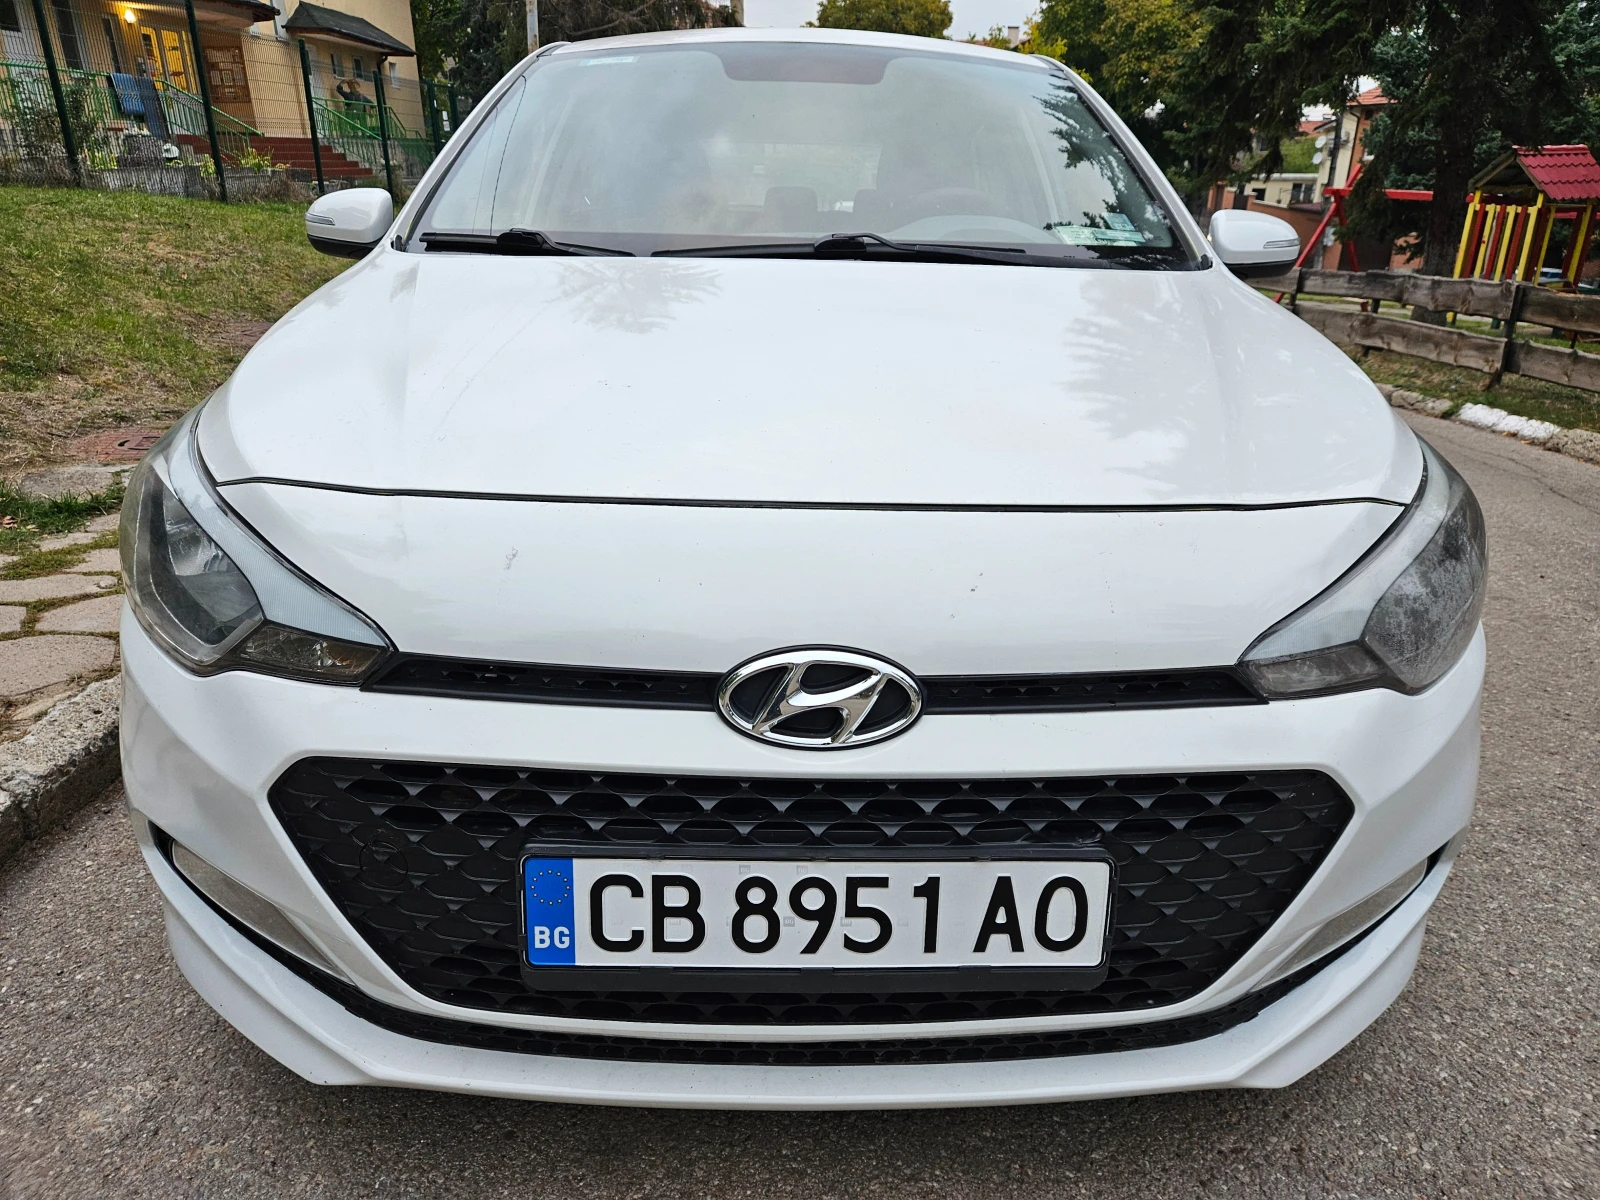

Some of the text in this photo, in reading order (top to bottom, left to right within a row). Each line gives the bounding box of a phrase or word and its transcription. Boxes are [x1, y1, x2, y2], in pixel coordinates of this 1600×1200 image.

[534, 926, 570, 949] BG
[589, 873, 1089, 954] CB 8951 AO
